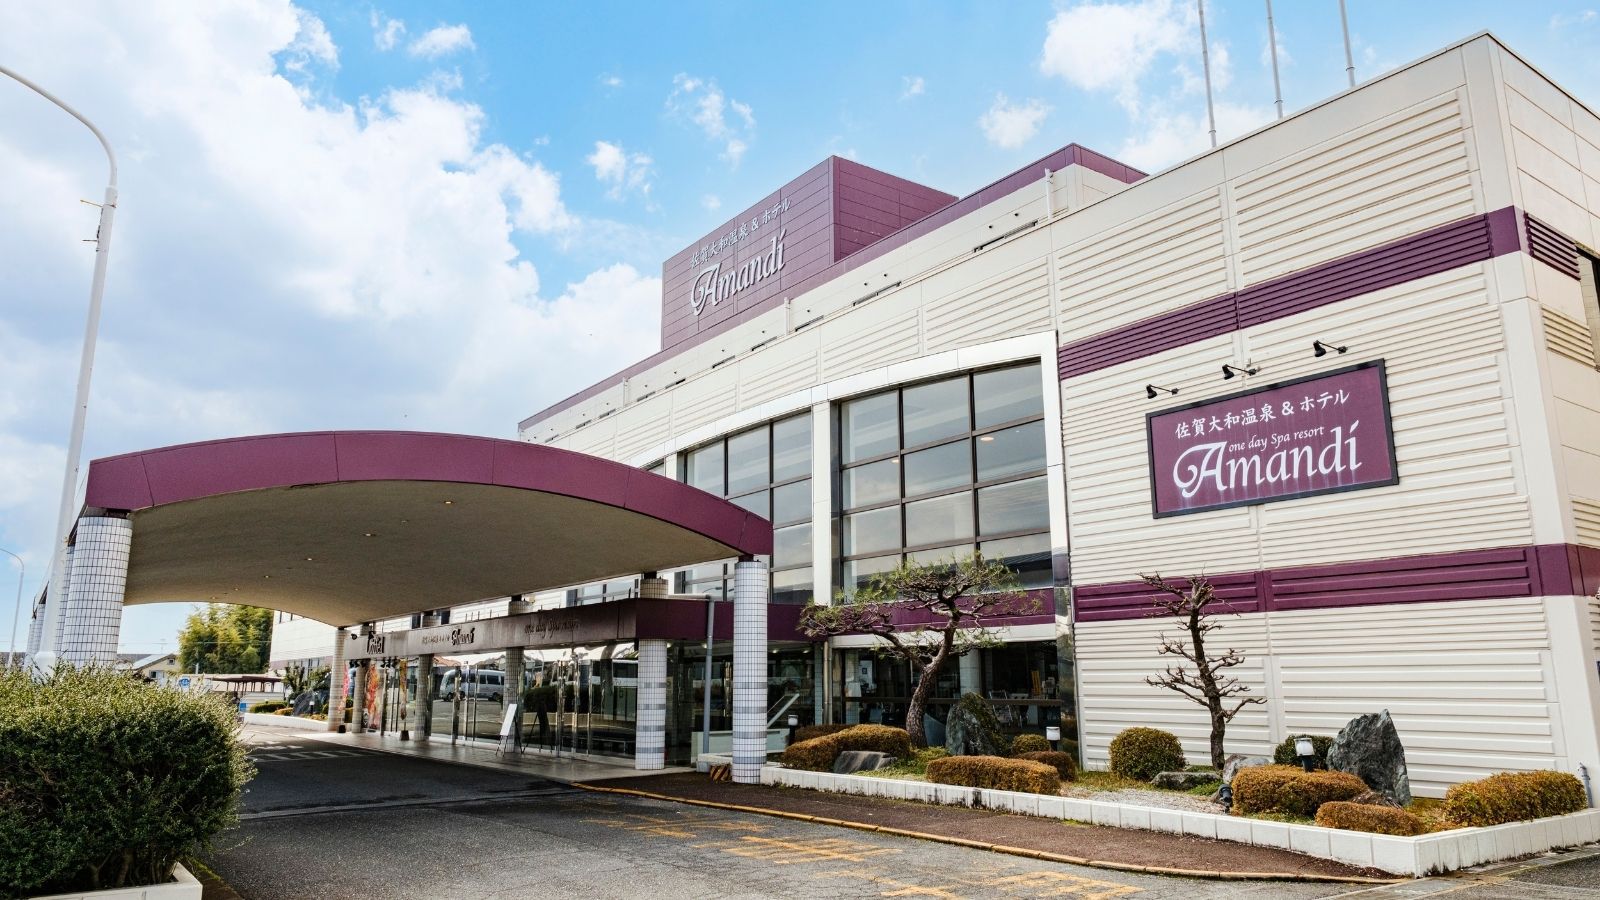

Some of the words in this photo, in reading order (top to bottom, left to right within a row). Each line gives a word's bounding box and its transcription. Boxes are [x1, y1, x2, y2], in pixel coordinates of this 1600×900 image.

[691, 224, 749, 268] 佐賀大和温泉
[751, 217, 760, 231] &
[762, 198, 790, 224] ホテル
[1175, 403, 1276, 438] 佐賀大和温泉
[1281, 401, 1295, 416] &
[1300, 389, 1350, 412] ホテル
[1229, 441, 1246, 453] one
[1248, 434, 1268, 452] day
[1271, 433, 1290, 448] Spa
[1293, 426, 1325, 440] resort
